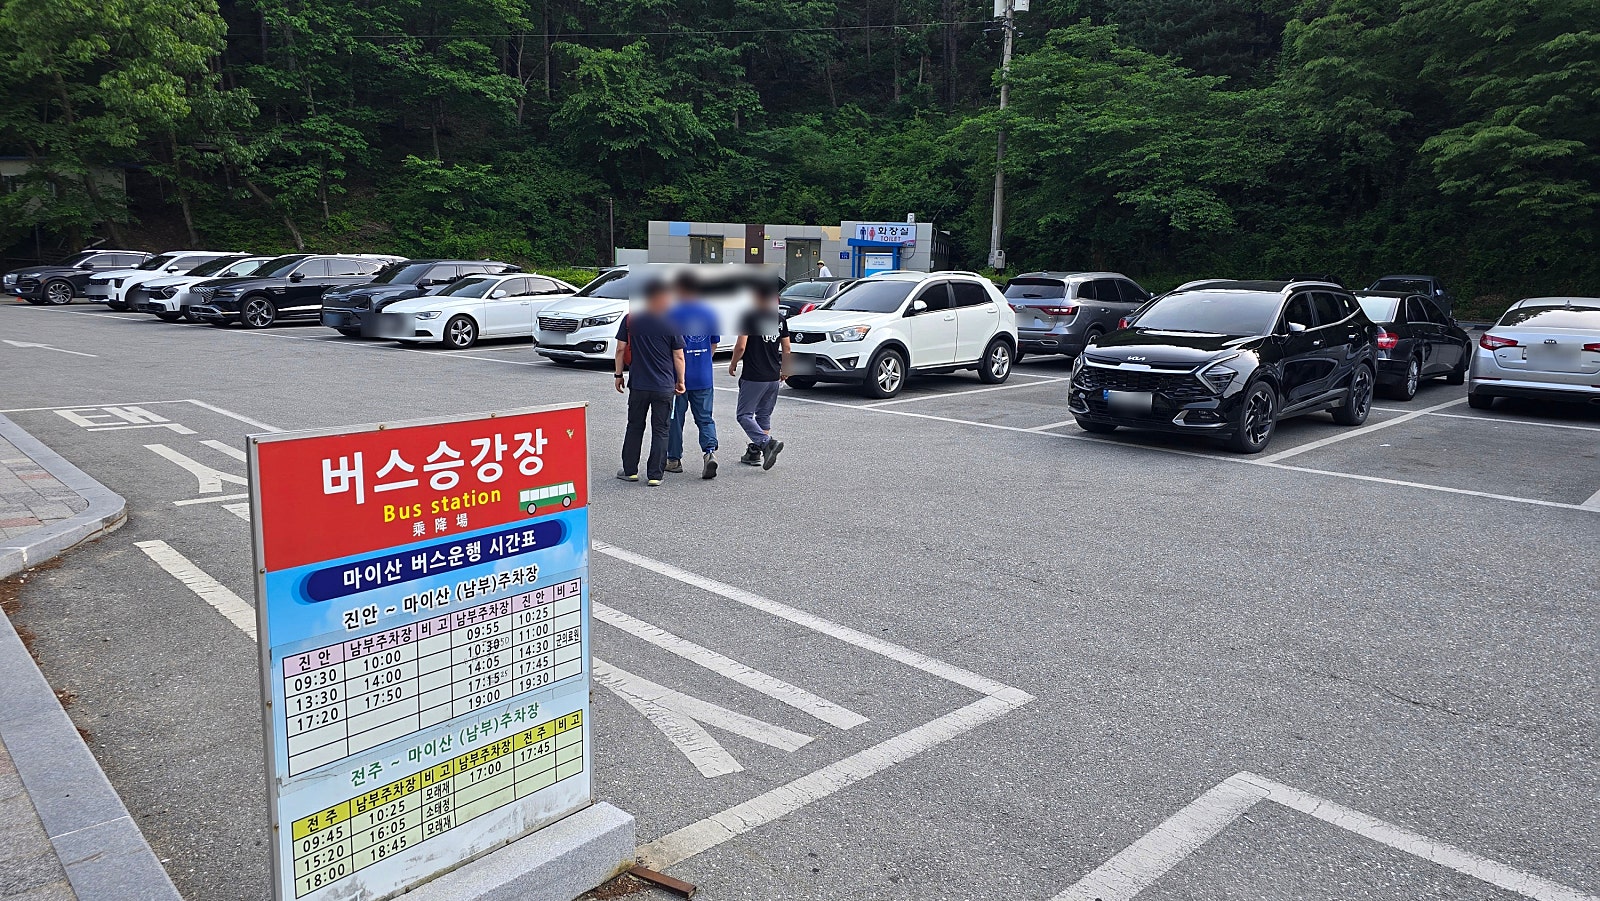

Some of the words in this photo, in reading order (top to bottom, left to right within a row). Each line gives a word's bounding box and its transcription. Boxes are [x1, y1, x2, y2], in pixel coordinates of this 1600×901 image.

[878, 226, 908, 236] 화장실
[321, 428, 549, 505] 버스승강장
[384, 503, 422, 523] Bus
[431, 489, 501, 515] station
[343, 558, 403, 590] 마이산
[411, 540, 481, 574] 버스운행
[490, 529, 537, 556] 시간표
[344, 606, 378, 630] 진안
[404, 586, 450, 613] 마이산
[456, 565, 538, 600] (남부)주차장
[350, 627, 412, 658] 남부주차장
[456, 600, 509, 626] 남부주차장
[294, 668, 337, 692] 09:30
[364, 650, 401, 671] 10:00
[467, 621, 499, 640] 09:55
[520, 607, 548, 625] 10:25
[296, 688, 338, 712] 13:30
[364, 668, 402, 690] 14:00
[520, 624, 548, 642] 11:00
[298, 708, 338, 730] 17:20
[365, 686, 402, 709] 17:50
[468, 656, 500, 675] 14:05
[520, 640, 548, 658] 14:30
[468, 672, 500, 692] 17:15
[520, 656, 548, 674] 17:45
[468, 690, 500, 710] 19:00
[520, 672, 548, 692] 19:30
[352, 762, 382, 787] 전주
[408, 734, 452, 762] 마이산
[460, 702, 540, 746] (남부)주차장
[356, 777, 416, 812] 남부주차장
[459, 739, 511, 771] 남부주차장
[303, 826, 343, 852] 09:45
[370, 800, 405, 824] 10:25
[426, 780, 450, 801] 모래재
[470, 760, 502, 783] 17:00
[520, 741, 550, 762] 17:45
[304, 844, 344, 872] 15:20
[370, 818, 406, 842] 16:05
[426, 798, 450, 818] 소태정
[306, 863, 345, 890] 18:00
[370, 836, 406, 861] 18:45
[427, 816, 451, 836] 모래재
